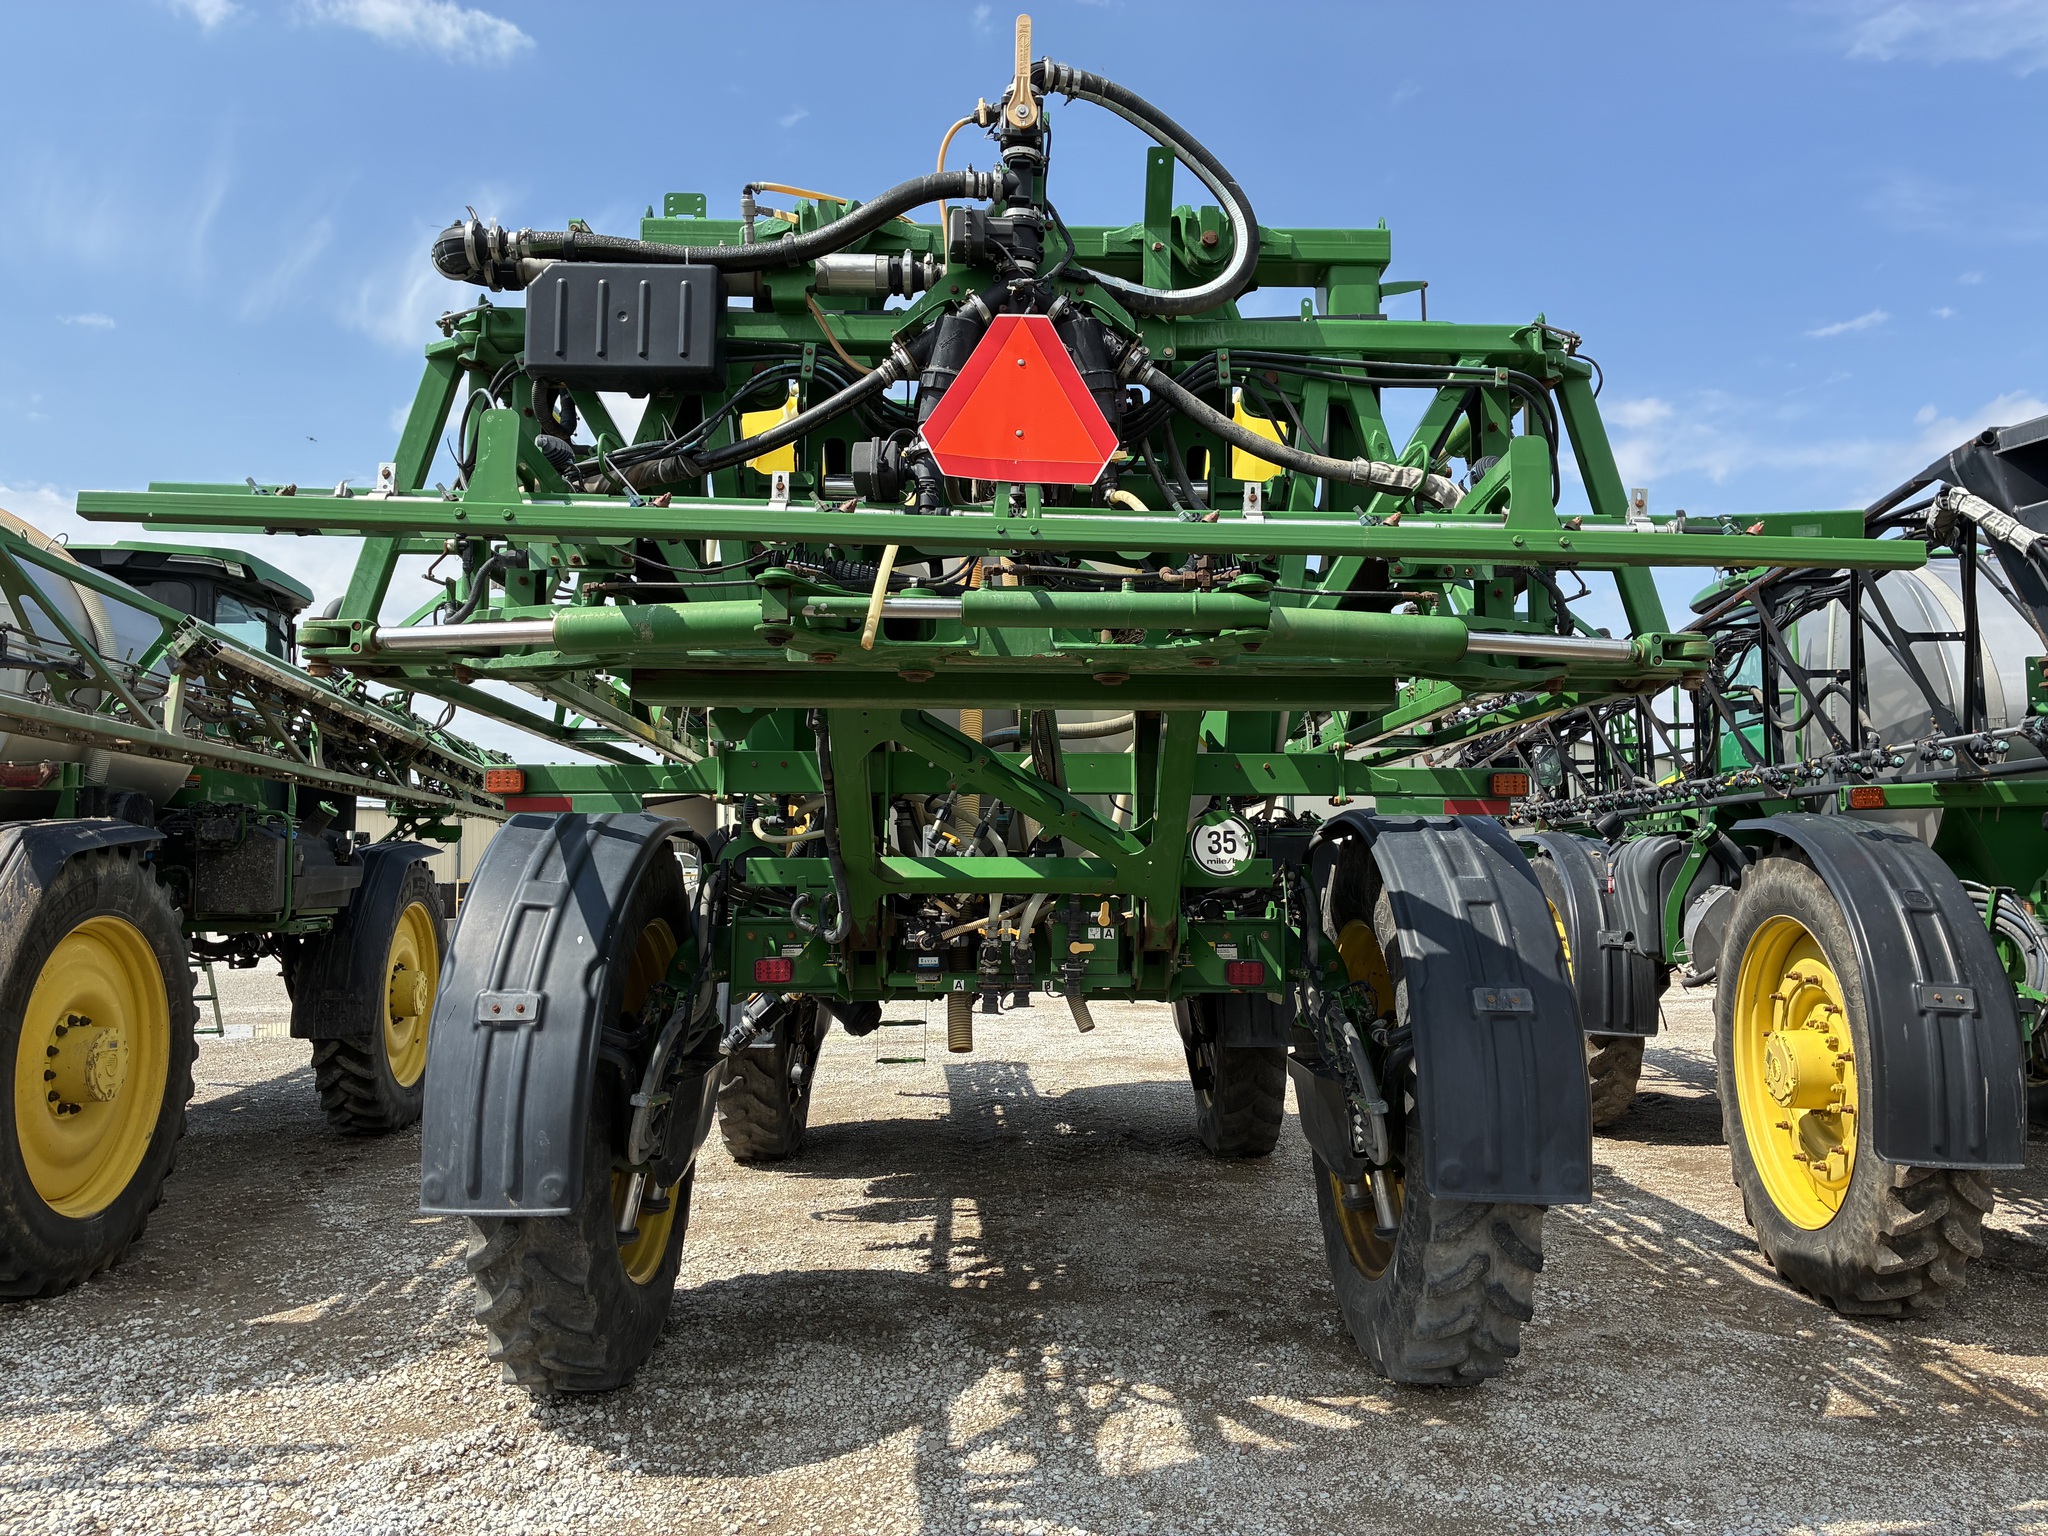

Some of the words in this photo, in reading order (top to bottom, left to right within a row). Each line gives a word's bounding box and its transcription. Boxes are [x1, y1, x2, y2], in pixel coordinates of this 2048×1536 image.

[1207, 830, 1237, 855] 35
[1104, 928, 1113, 939] A
[954, 980, 963, 990] A
